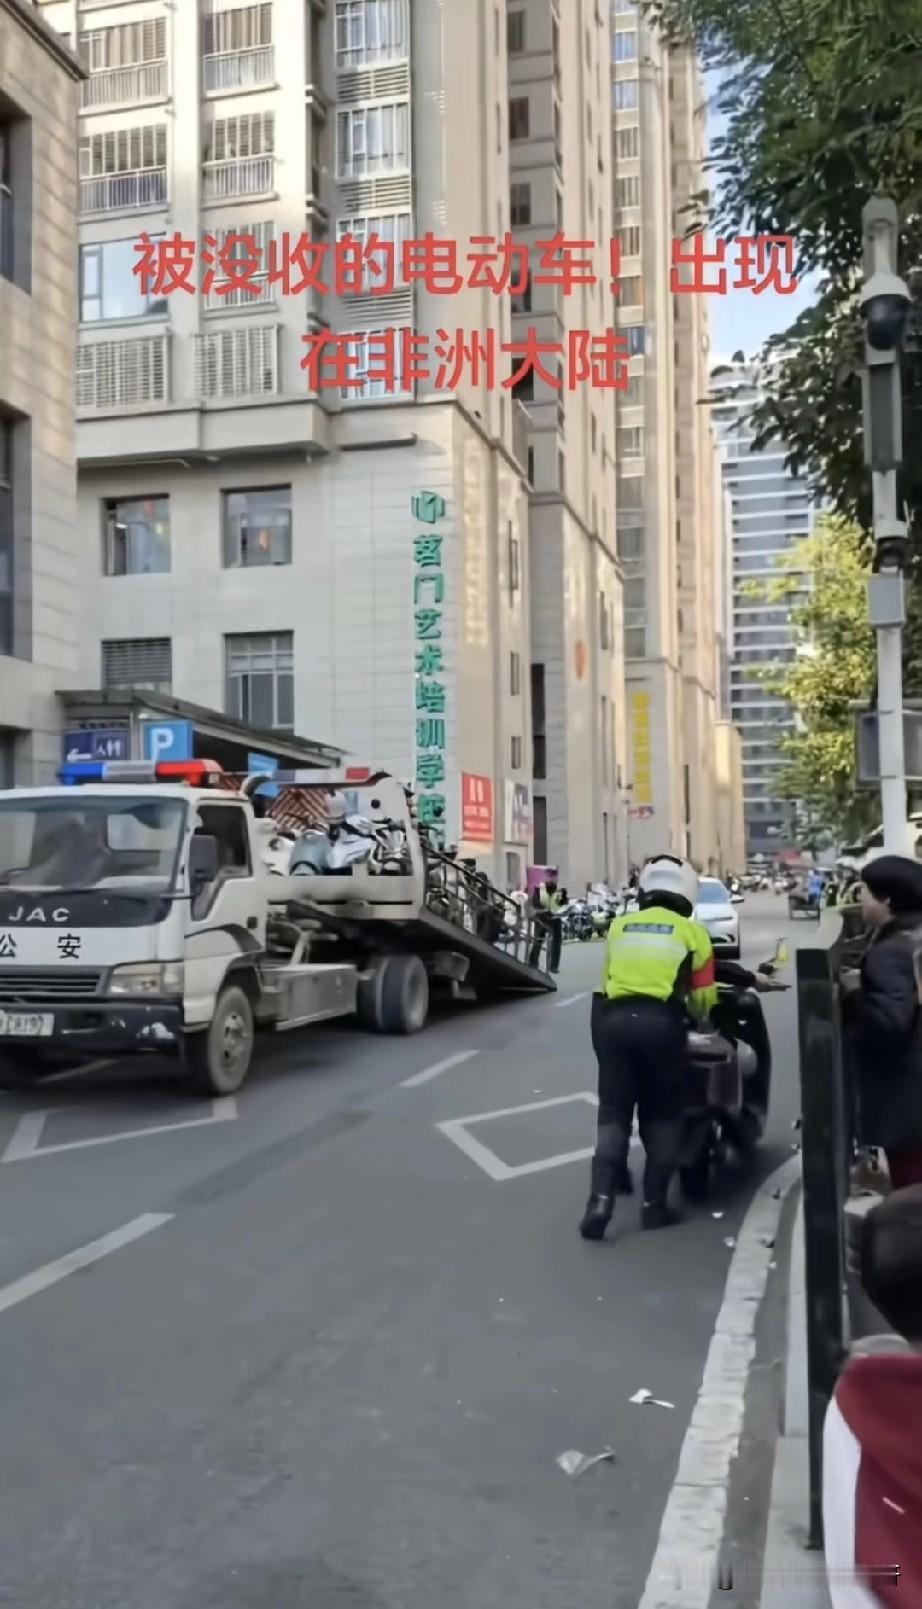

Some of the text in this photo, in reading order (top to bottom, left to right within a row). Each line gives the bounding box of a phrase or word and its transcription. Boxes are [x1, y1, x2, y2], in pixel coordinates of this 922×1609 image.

[149, 727, 175, 761] P
[8, 905, 71, 923] JAC
[0, 932, 82, 960] 公安
